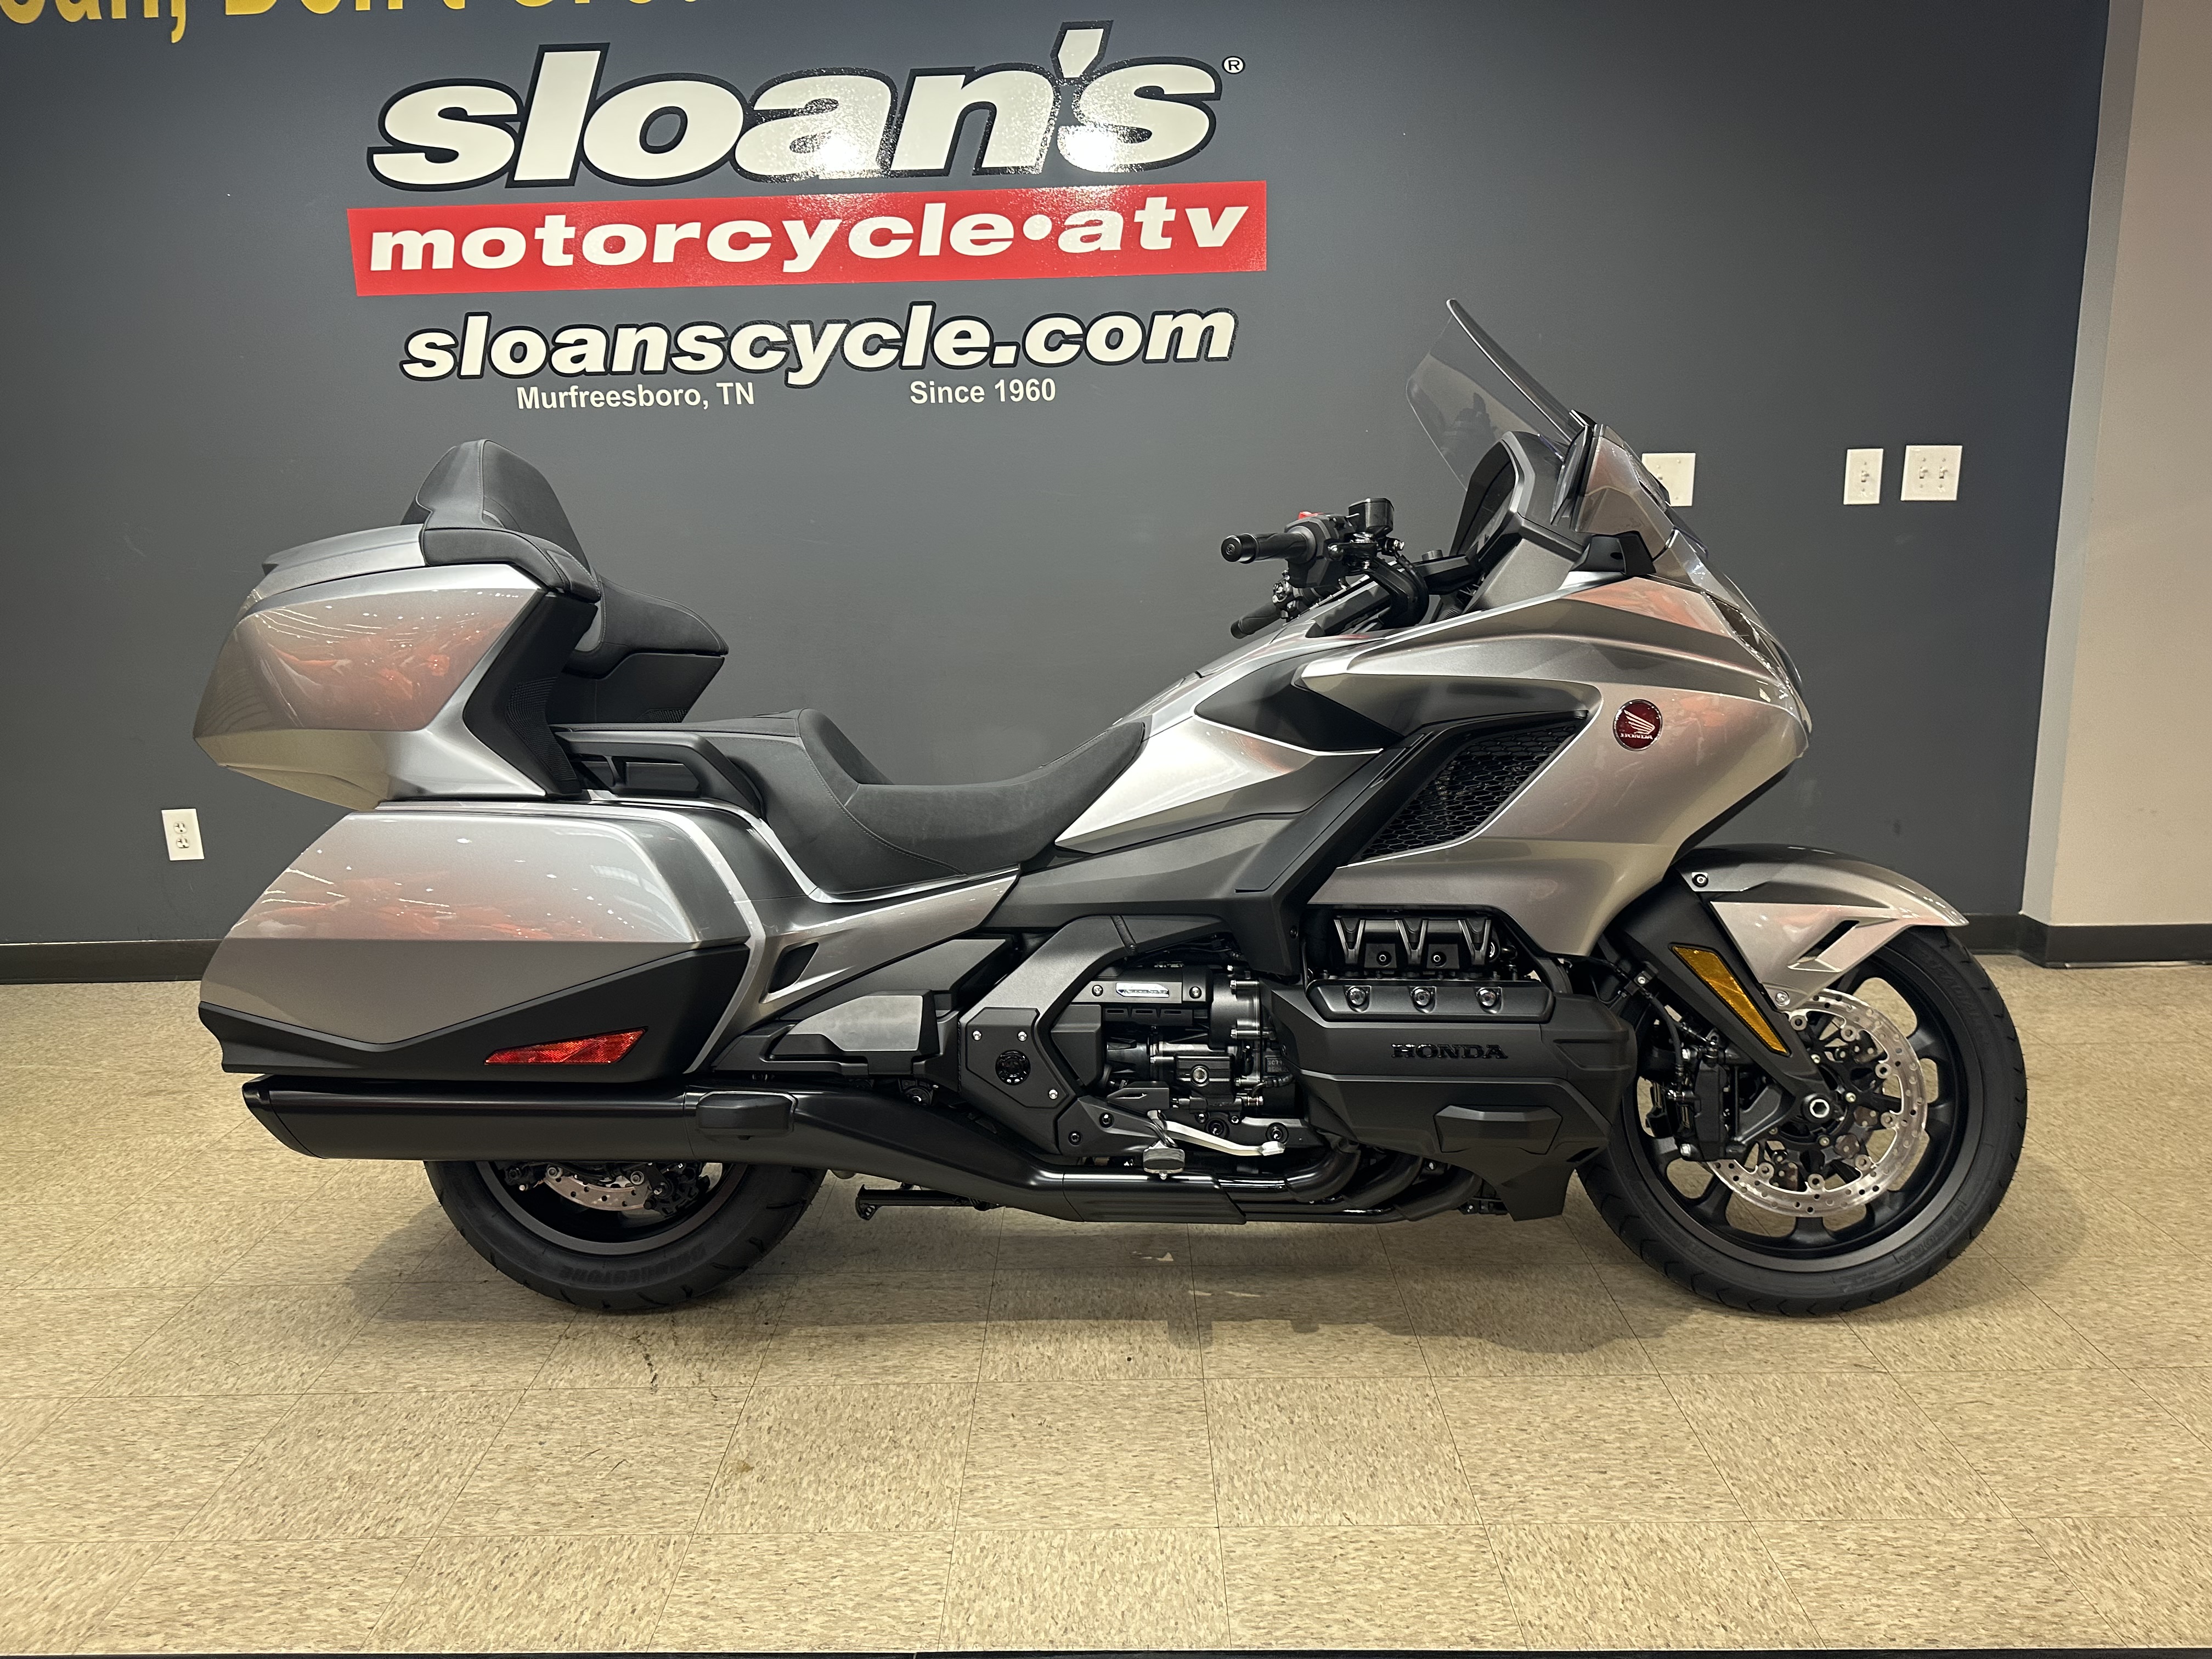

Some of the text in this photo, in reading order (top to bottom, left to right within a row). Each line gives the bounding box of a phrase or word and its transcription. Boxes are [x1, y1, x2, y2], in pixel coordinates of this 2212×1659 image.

[366, 20, 1222, 191] sloan's
[400, 301, 1238, 388] sloanscycle.com
[517, 382, 754, 409] Murfreesboro, TN
[910, 378, 1056, 404] Since 1960
[1391, 1043, 1508, 1059] HONDA
